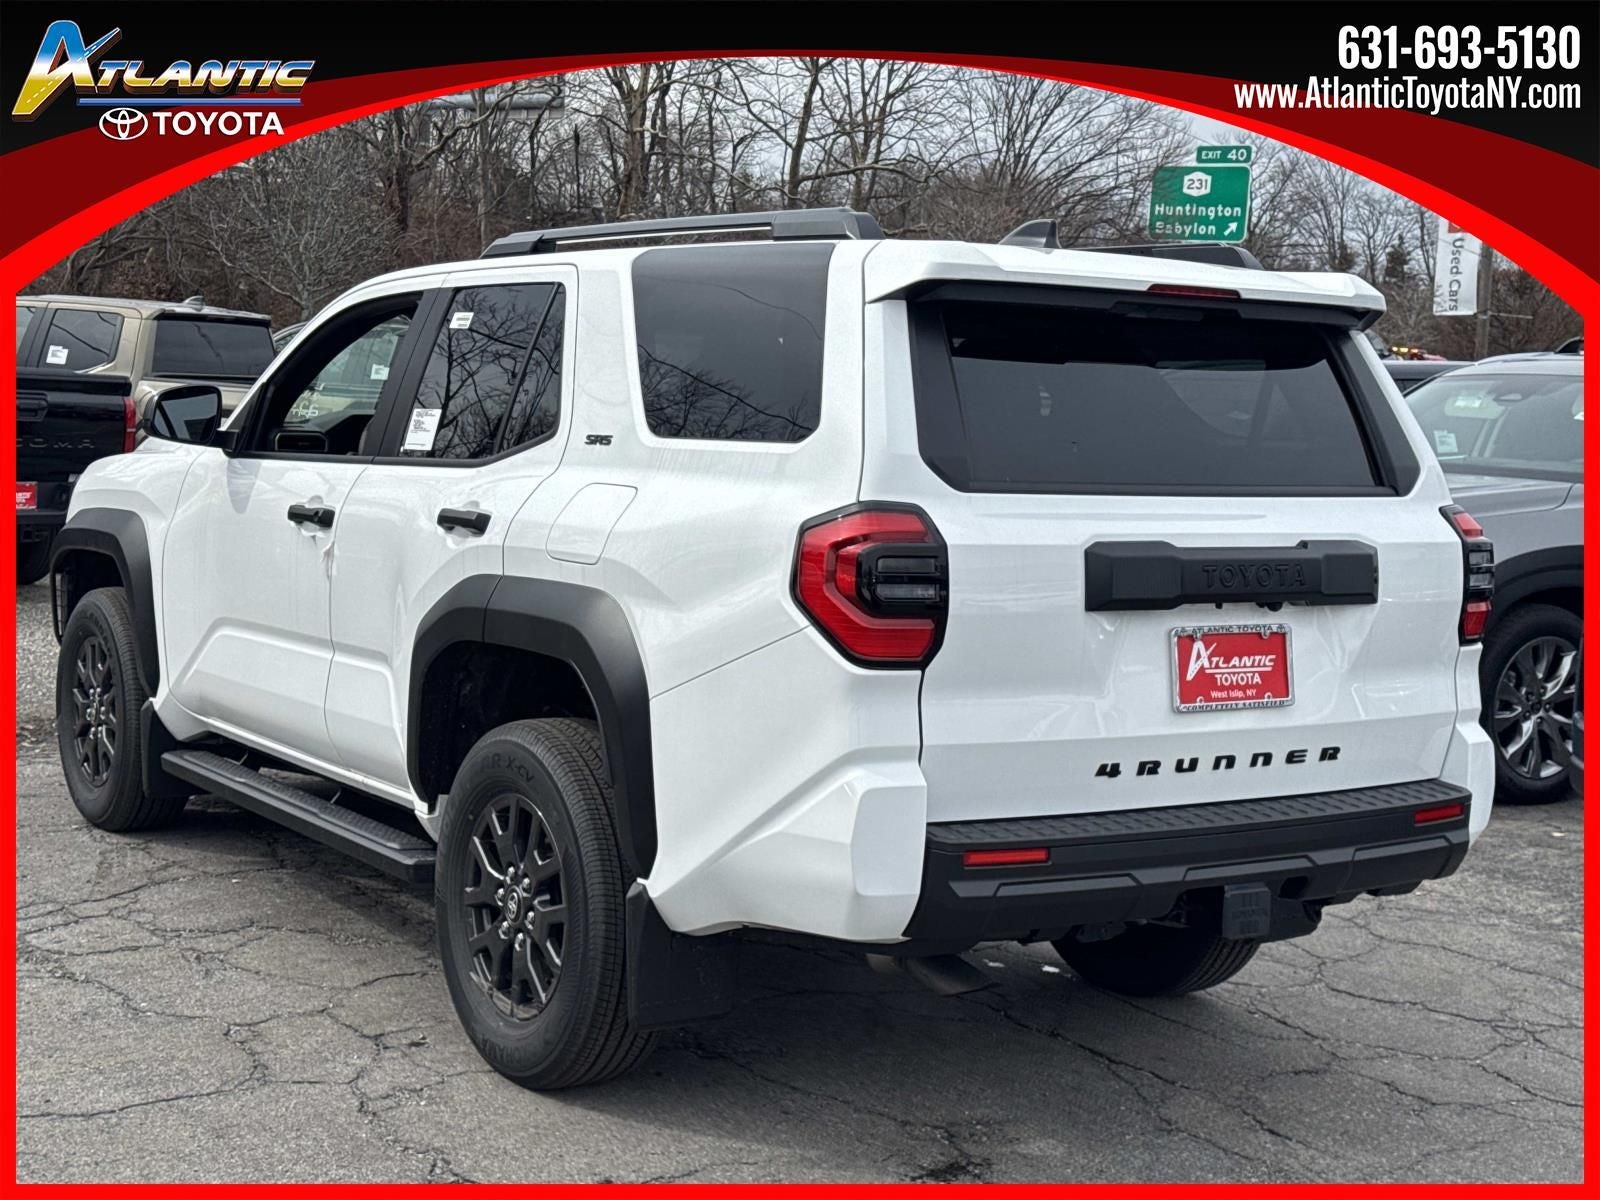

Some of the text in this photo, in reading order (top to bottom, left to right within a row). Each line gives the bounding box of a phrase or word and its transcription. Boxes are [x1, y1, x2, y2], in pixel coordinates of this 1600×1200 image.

[1201, 149, 1247, 161] EXIT 40
[1186, 178, 1209, 190] 231
[1154, 203, 1242, 221] Huntington
[1448, 238, 1465, 312] Used Cars
[584, 434, 614, 446] SR5
[1203, 563, 1308, 590] TOYOTA
[1237, 624, 1273, 632] TOYOTA
[1186, 640, 1277, 681] ATLANTIC
[1214, 673, 1262, 686] TOYOTA
[1210, 690, 1228, 699] West
[1246, 689, 1257, 697] NY
[1094, 746, 1342, 779] 4RUNNER
